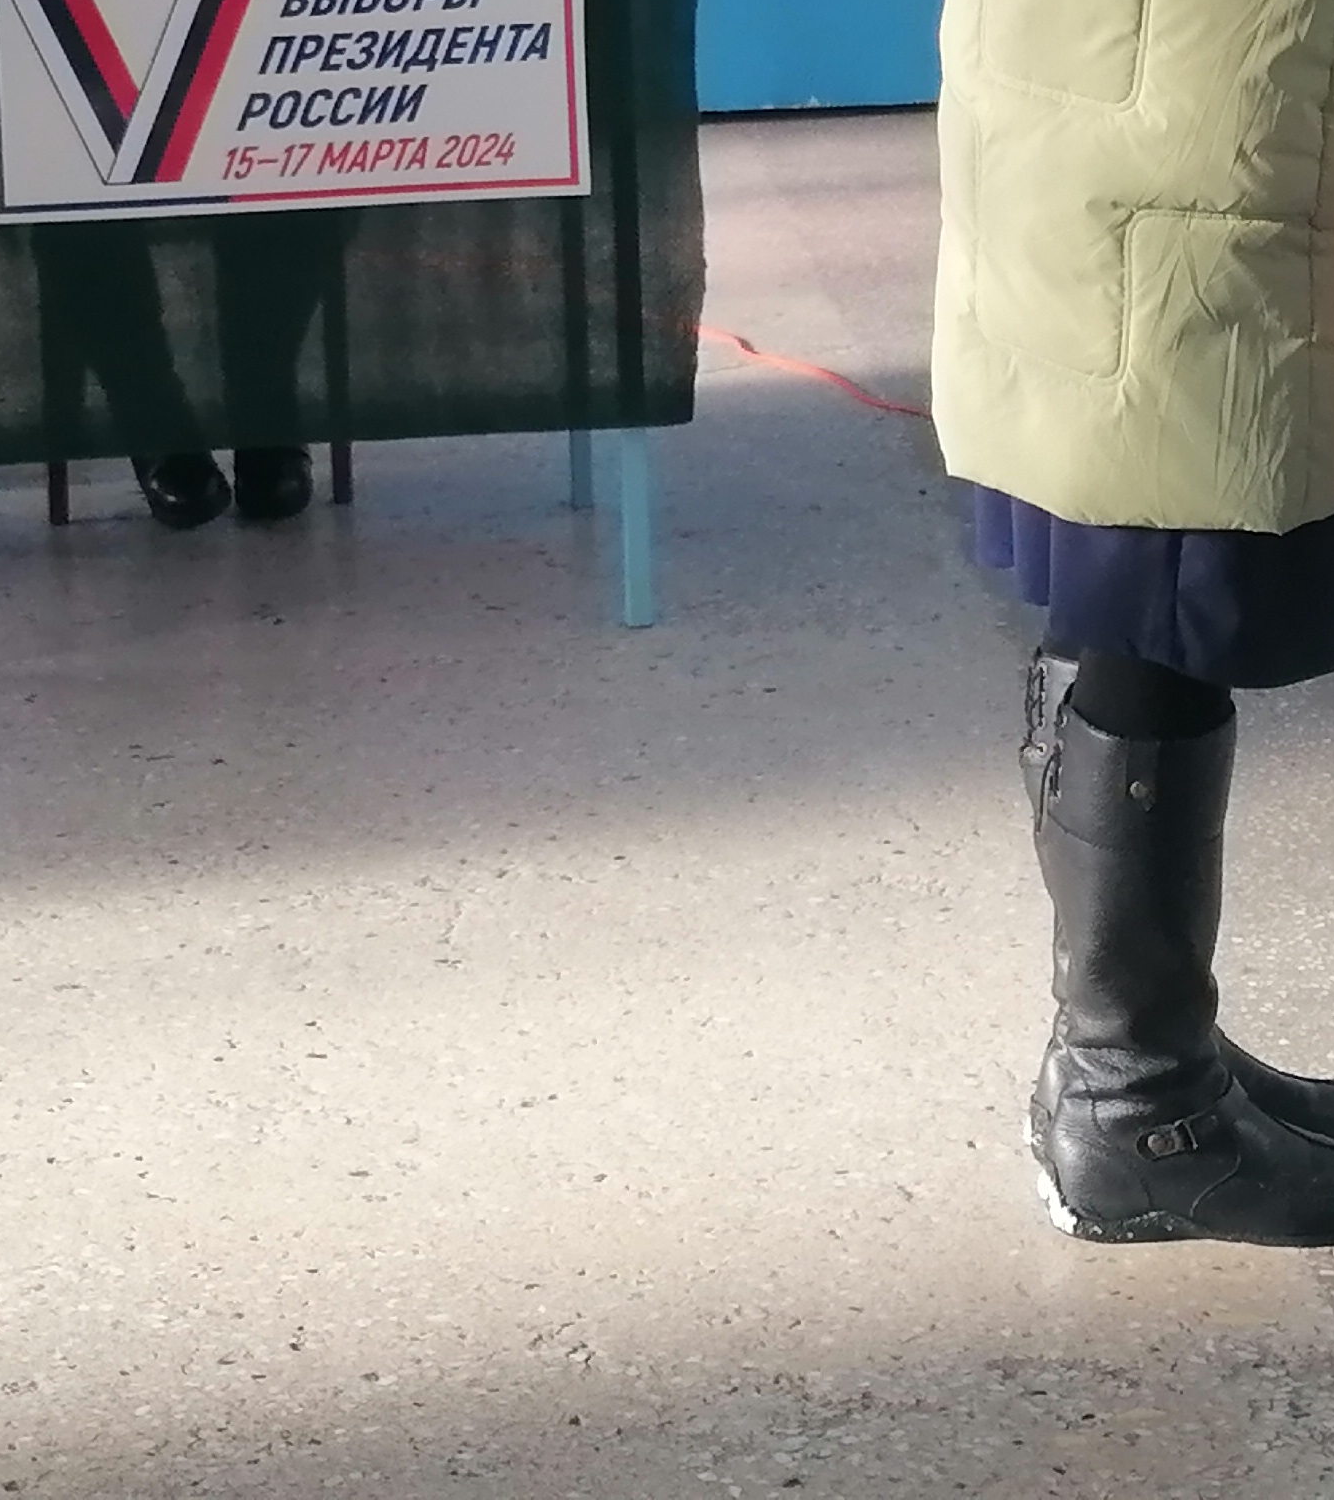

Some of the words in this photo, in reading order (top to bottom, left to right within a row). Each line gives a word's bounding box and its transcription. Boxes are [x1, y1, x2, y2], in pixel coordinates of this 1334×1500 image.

[258, 22, 553, 76] ПРЕЗИДЕНТА
[236, 83, 428, 132] РОССИИ
[317, 136, 431, 177] МАРТА
[435, 132, 517, 170] 2024
